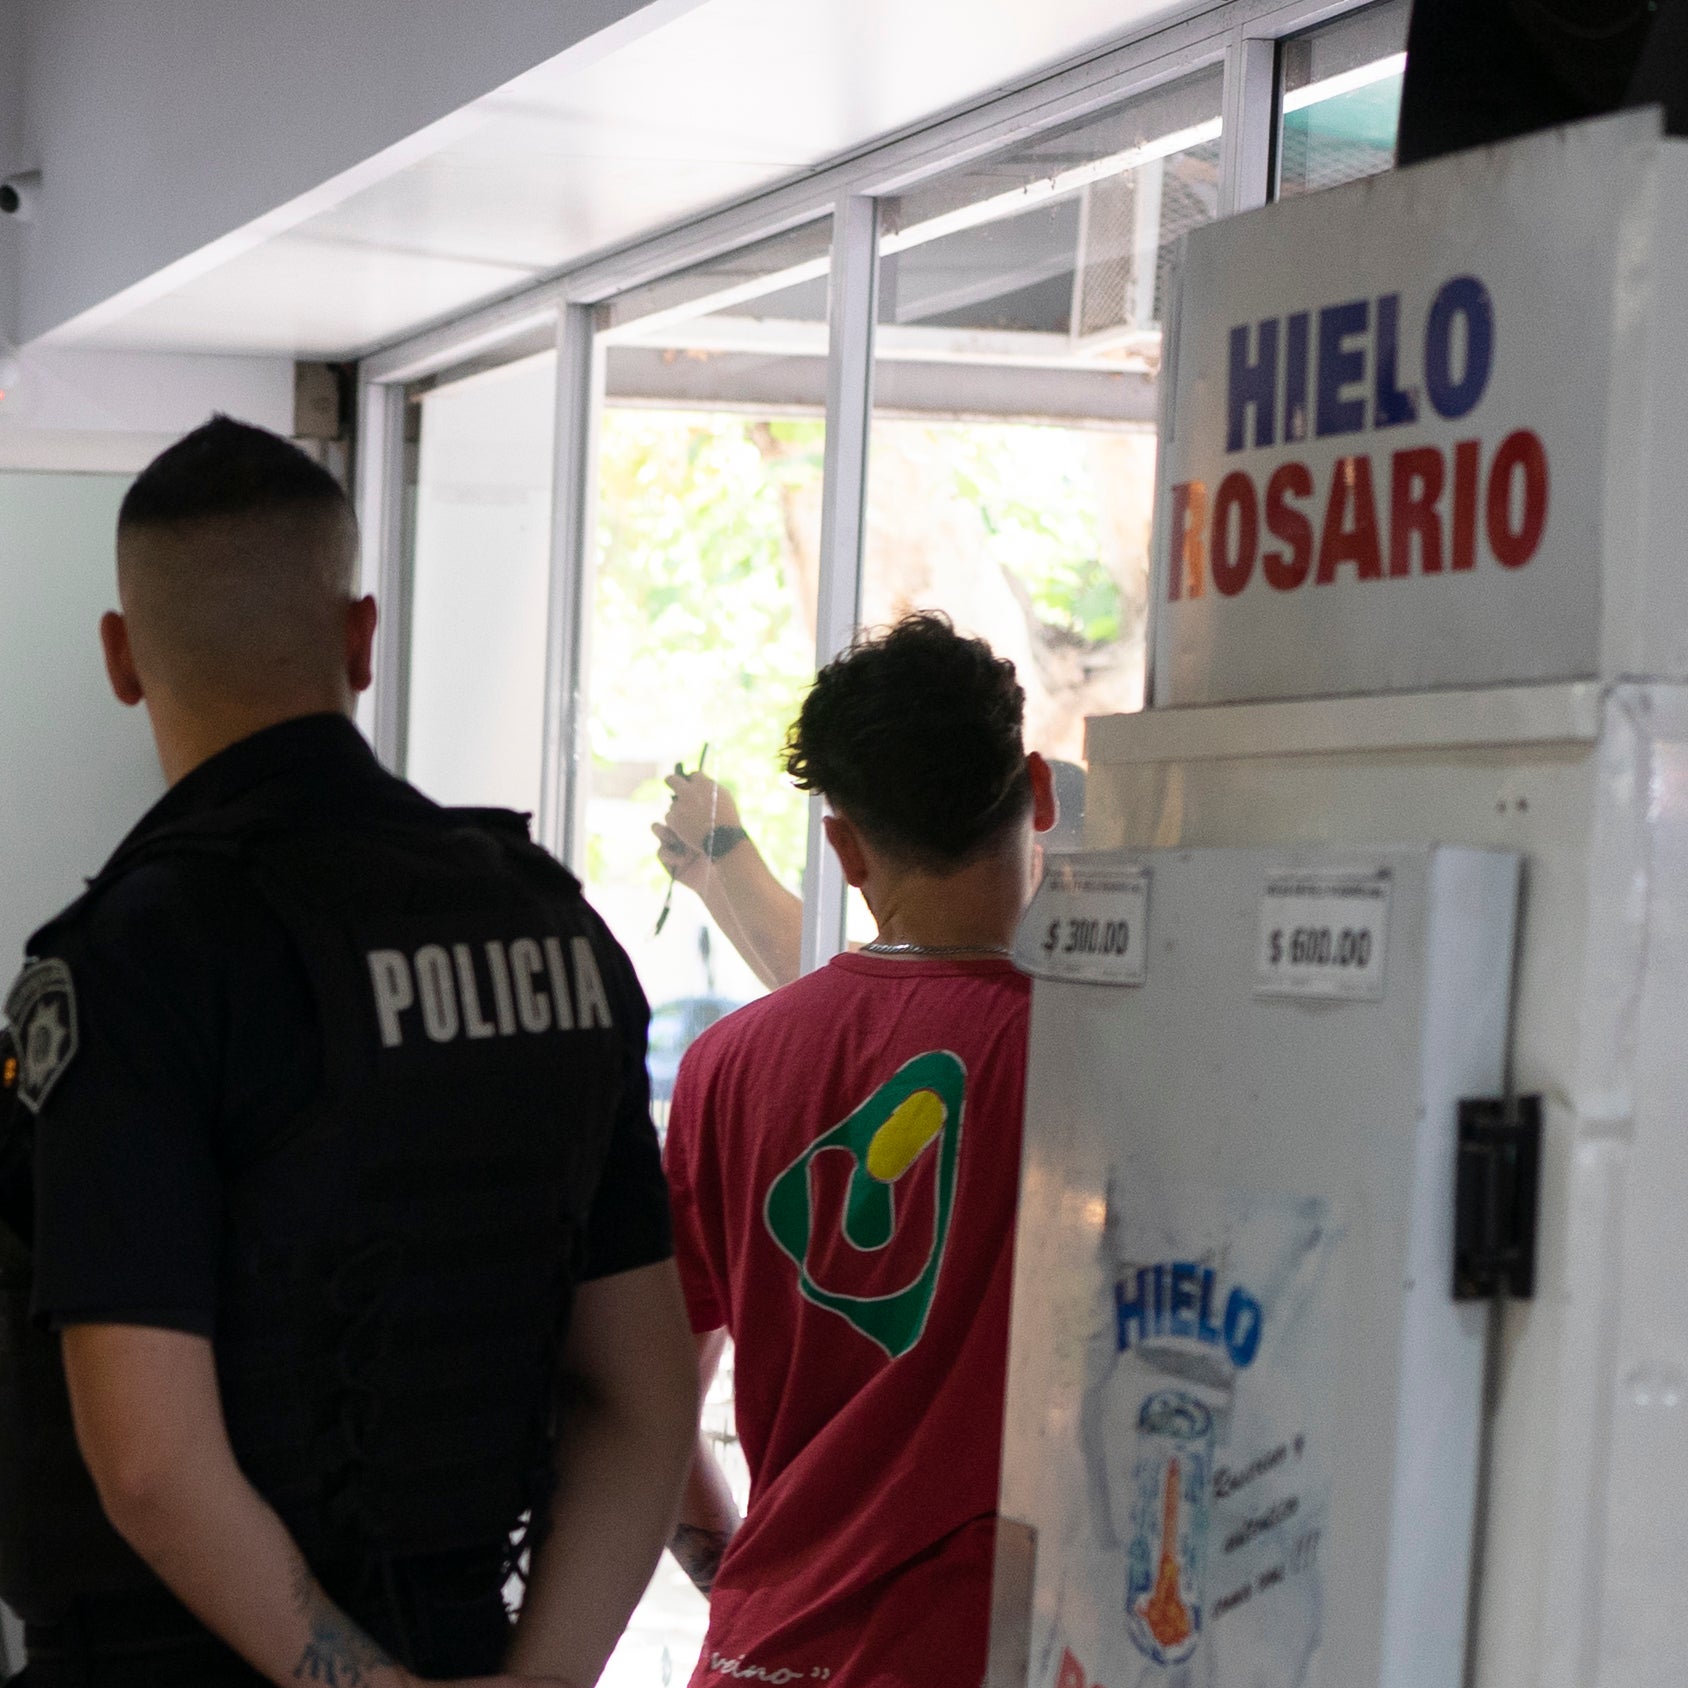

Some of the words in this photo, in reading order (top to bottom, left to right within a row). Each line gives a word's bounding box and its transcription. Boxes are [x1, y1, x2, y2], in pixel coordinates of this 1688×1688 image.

[1226, 273, 1495, 454] HIELO
[1169, 426, 1550, 601] ROSARIO
[367, 935, 614, 1048] POLICIA
[1042, 917, 1061, 956] $
[1114, 1259, 1264, 1370] HIELO
